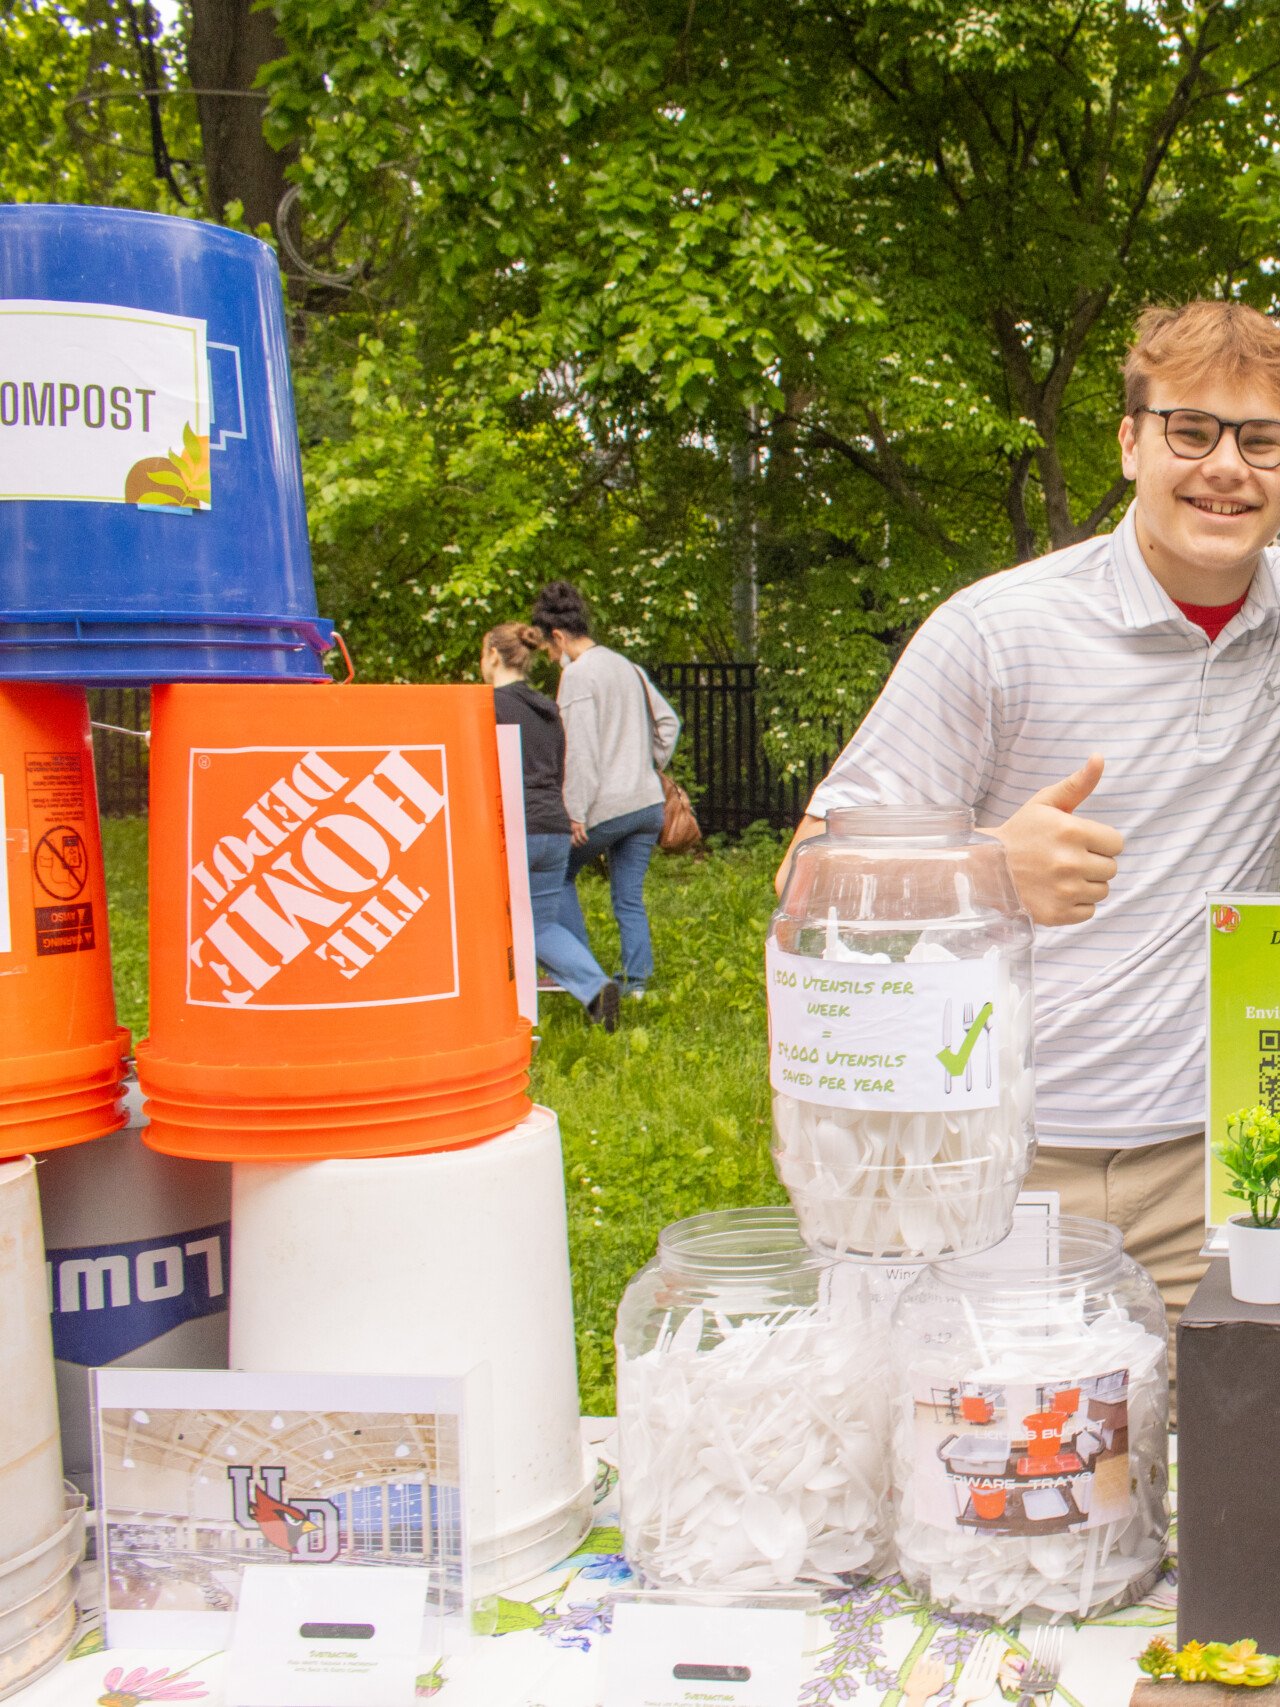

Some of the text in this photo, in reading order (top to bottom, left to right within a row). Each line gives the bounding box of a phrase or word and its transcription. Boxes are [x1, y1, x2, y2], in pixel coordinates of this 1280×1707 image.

[192, 750, 350, 911] DEPOT
[190, 749, 446, 1004] HOME
[314, 874, 430, 980] THE
[803, 976, 875, 994] UTENSILS
[881, 981, 914, 995] PER
[807, 1002, 850, 1017] WEEK
[782, 1069, 895, 1093] SAVED PER YEAR
[826, 1051, 907, 1068] UTENSILS
[46, 1236, 224, 1313] LOW
